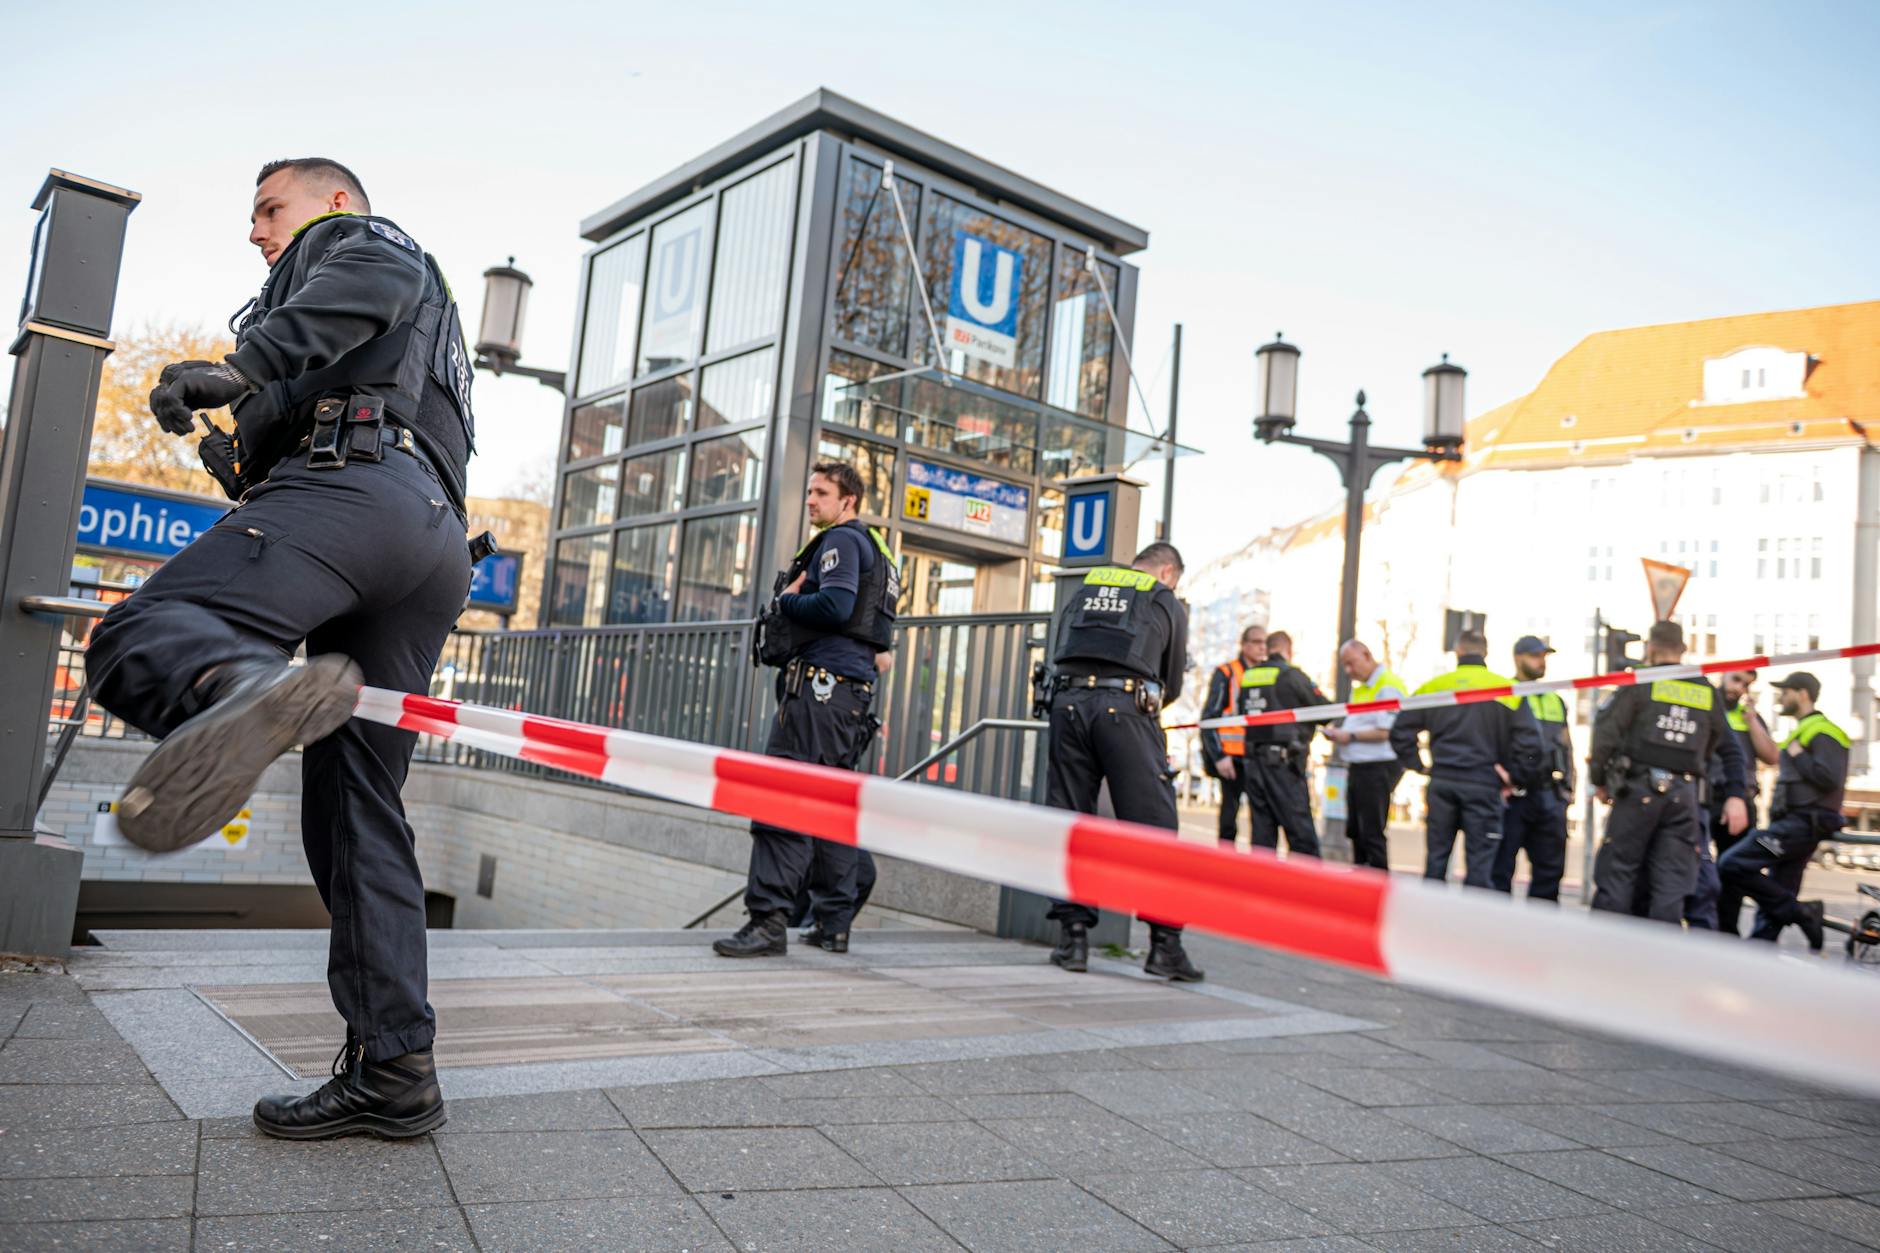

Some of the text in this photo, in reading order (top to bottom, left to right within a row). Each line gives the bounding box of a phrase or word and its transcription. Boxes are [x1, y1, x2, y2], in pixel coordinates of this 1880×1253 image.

[661, 235, 696, 314] U
[961, 238, 1014, 325] U
[78, 502, 204, 547] ophie-
[1072, 499, 1105, 551] U
[1089, 569, 1152, 587] POLIZEI
[1098, 586, 1120, 599] BE
[1083, 598, 1127, 613] 25315
